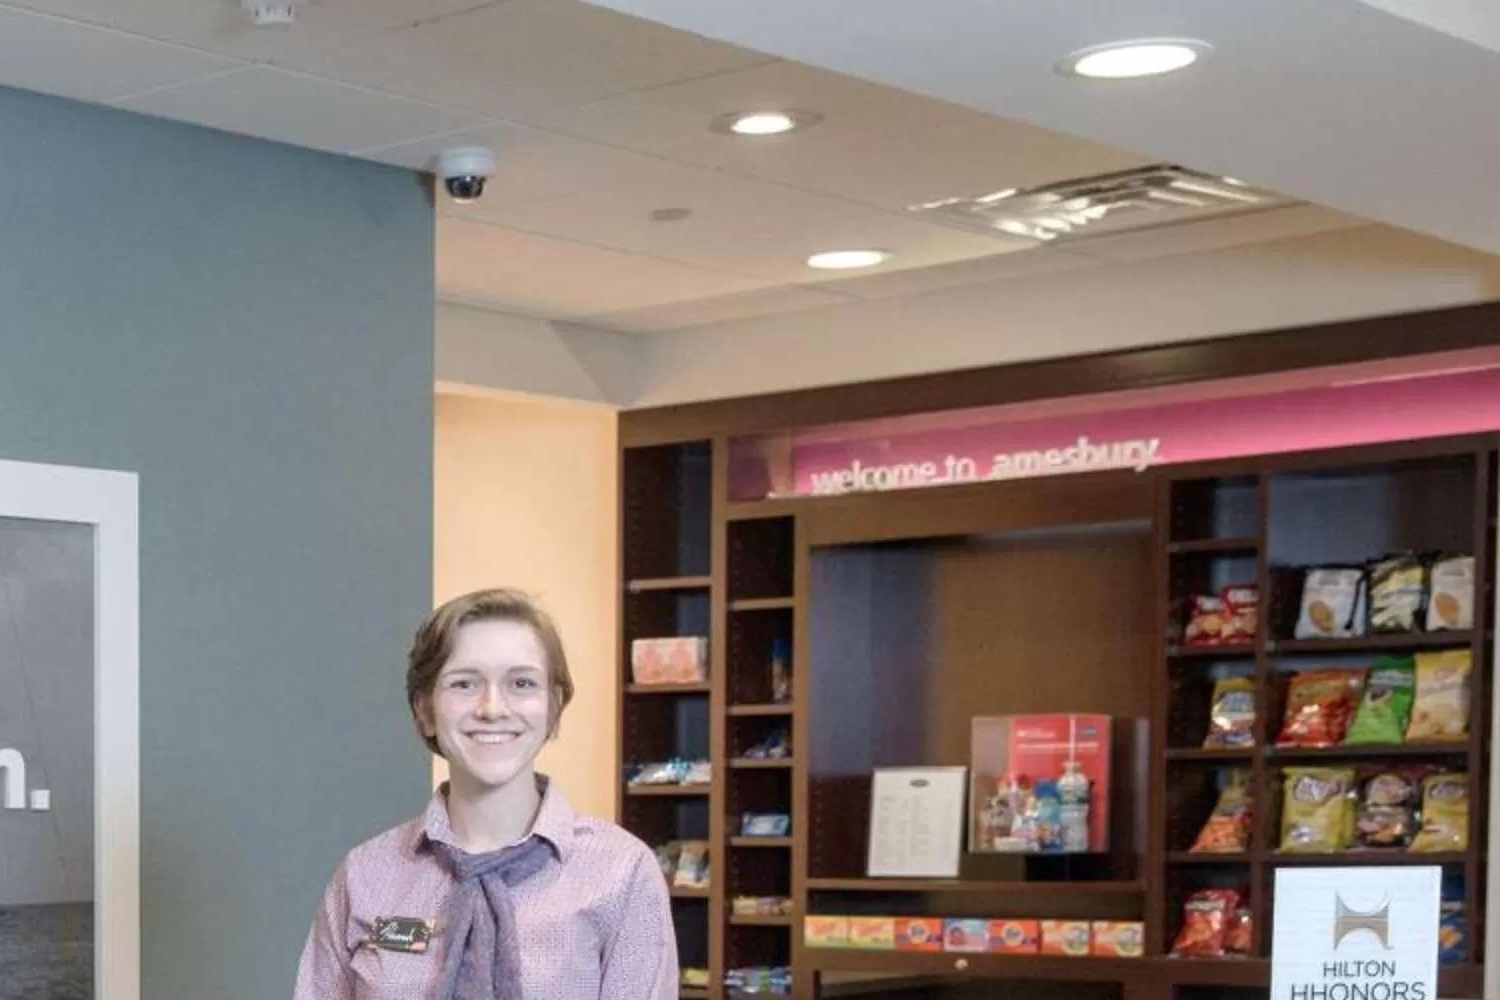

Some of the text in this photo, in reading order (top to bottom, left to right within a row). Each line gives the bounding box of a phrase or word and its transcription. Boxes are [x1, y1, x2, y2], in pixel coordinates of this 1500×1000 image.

[810, 459, 936, 496] welcome
[943, 454, 977, 483] to
[1323, 960, 1396, 978] HILTON
